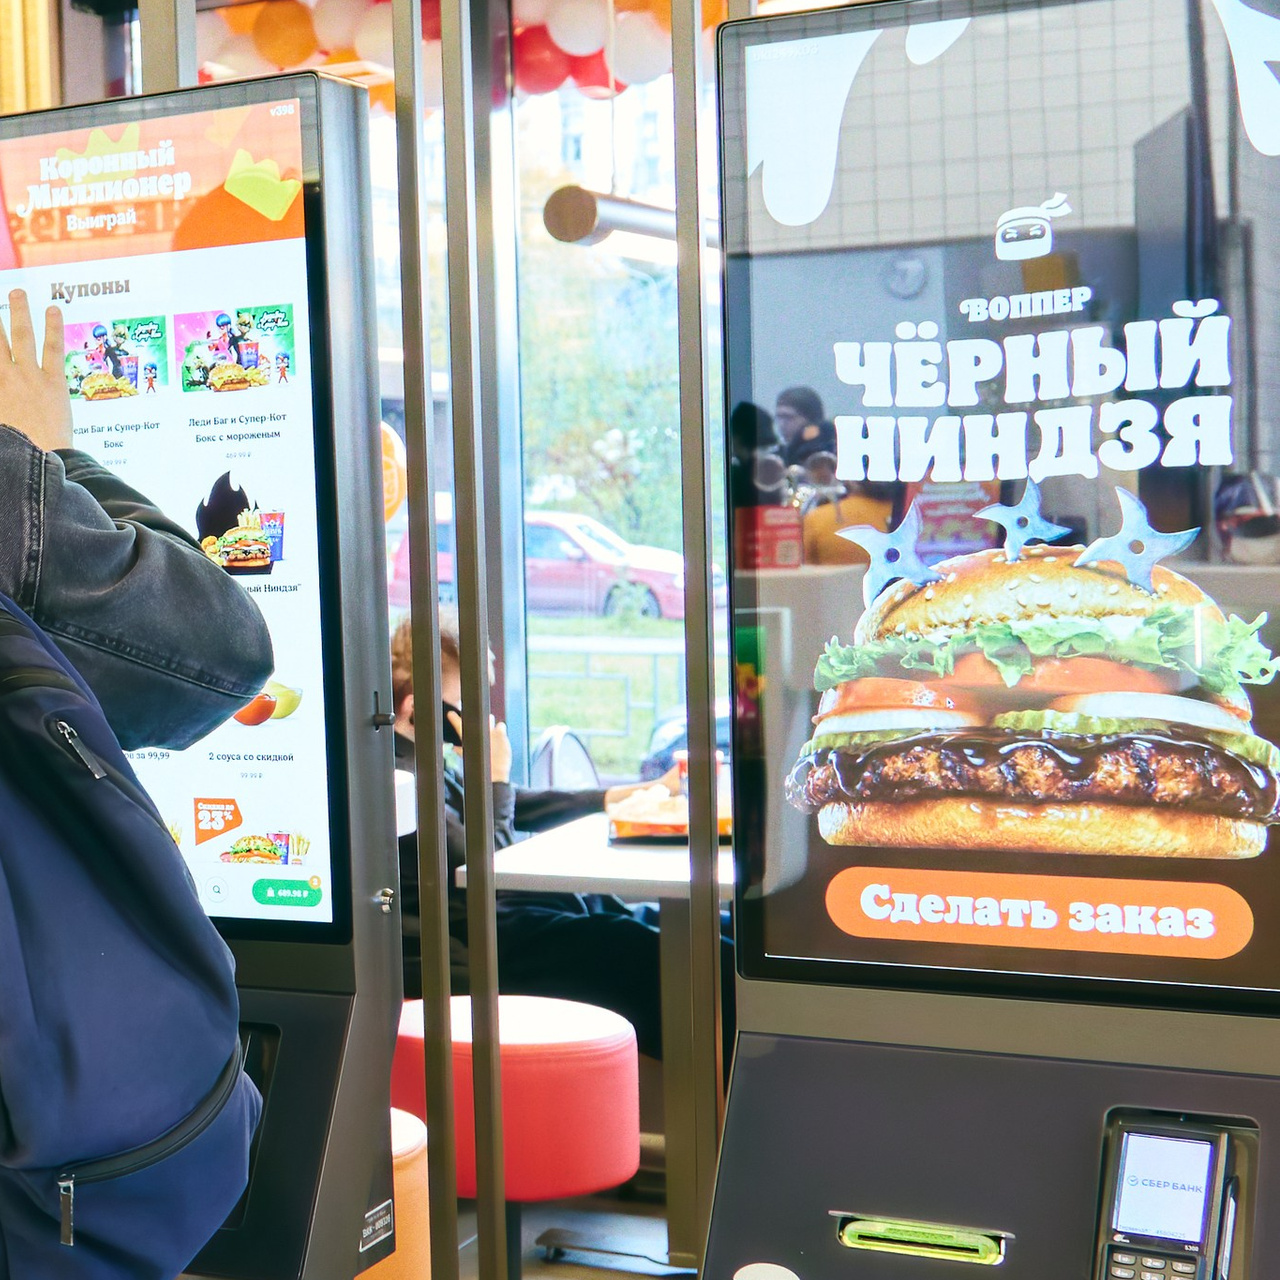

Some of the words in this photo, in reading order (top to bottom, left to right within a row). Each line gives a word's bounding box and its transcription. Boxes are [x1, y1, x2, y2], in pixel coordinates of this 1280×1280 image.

[39, 139, 175, 182] Коронный
[16, 172, 192, 217] Миллионер
[66, 208, 137, 232] Выиграй
[51, 279, 131, 305] Купоны
[833, 299, 1232, 407] ЧЁРНЫЙ
[91, 425, 106, 434] Баг
[115, 421, 160, 433] Супер-Кот
[189, 418, 212, 428] Леди
[214, 416, 228, 425] Баг
[238, 413, 287, 425] Супер-Кот
[103, 440, 124, 449] Бокс
[195, 433, 216, 443] Бокс
[226, 431, 281, 441] мороженым
[834, 395, 1233, 484] НИНДЗЯ
[148, 752, 170, 761] 99,99
[209, 753, 214, 761] 2
[216, 754, 241, 762] соуса
[256, 753, 294, 762] скидкой
[860, 883, 1058, 929] Сделать
[1068, 901, 1215, 940] заказ
